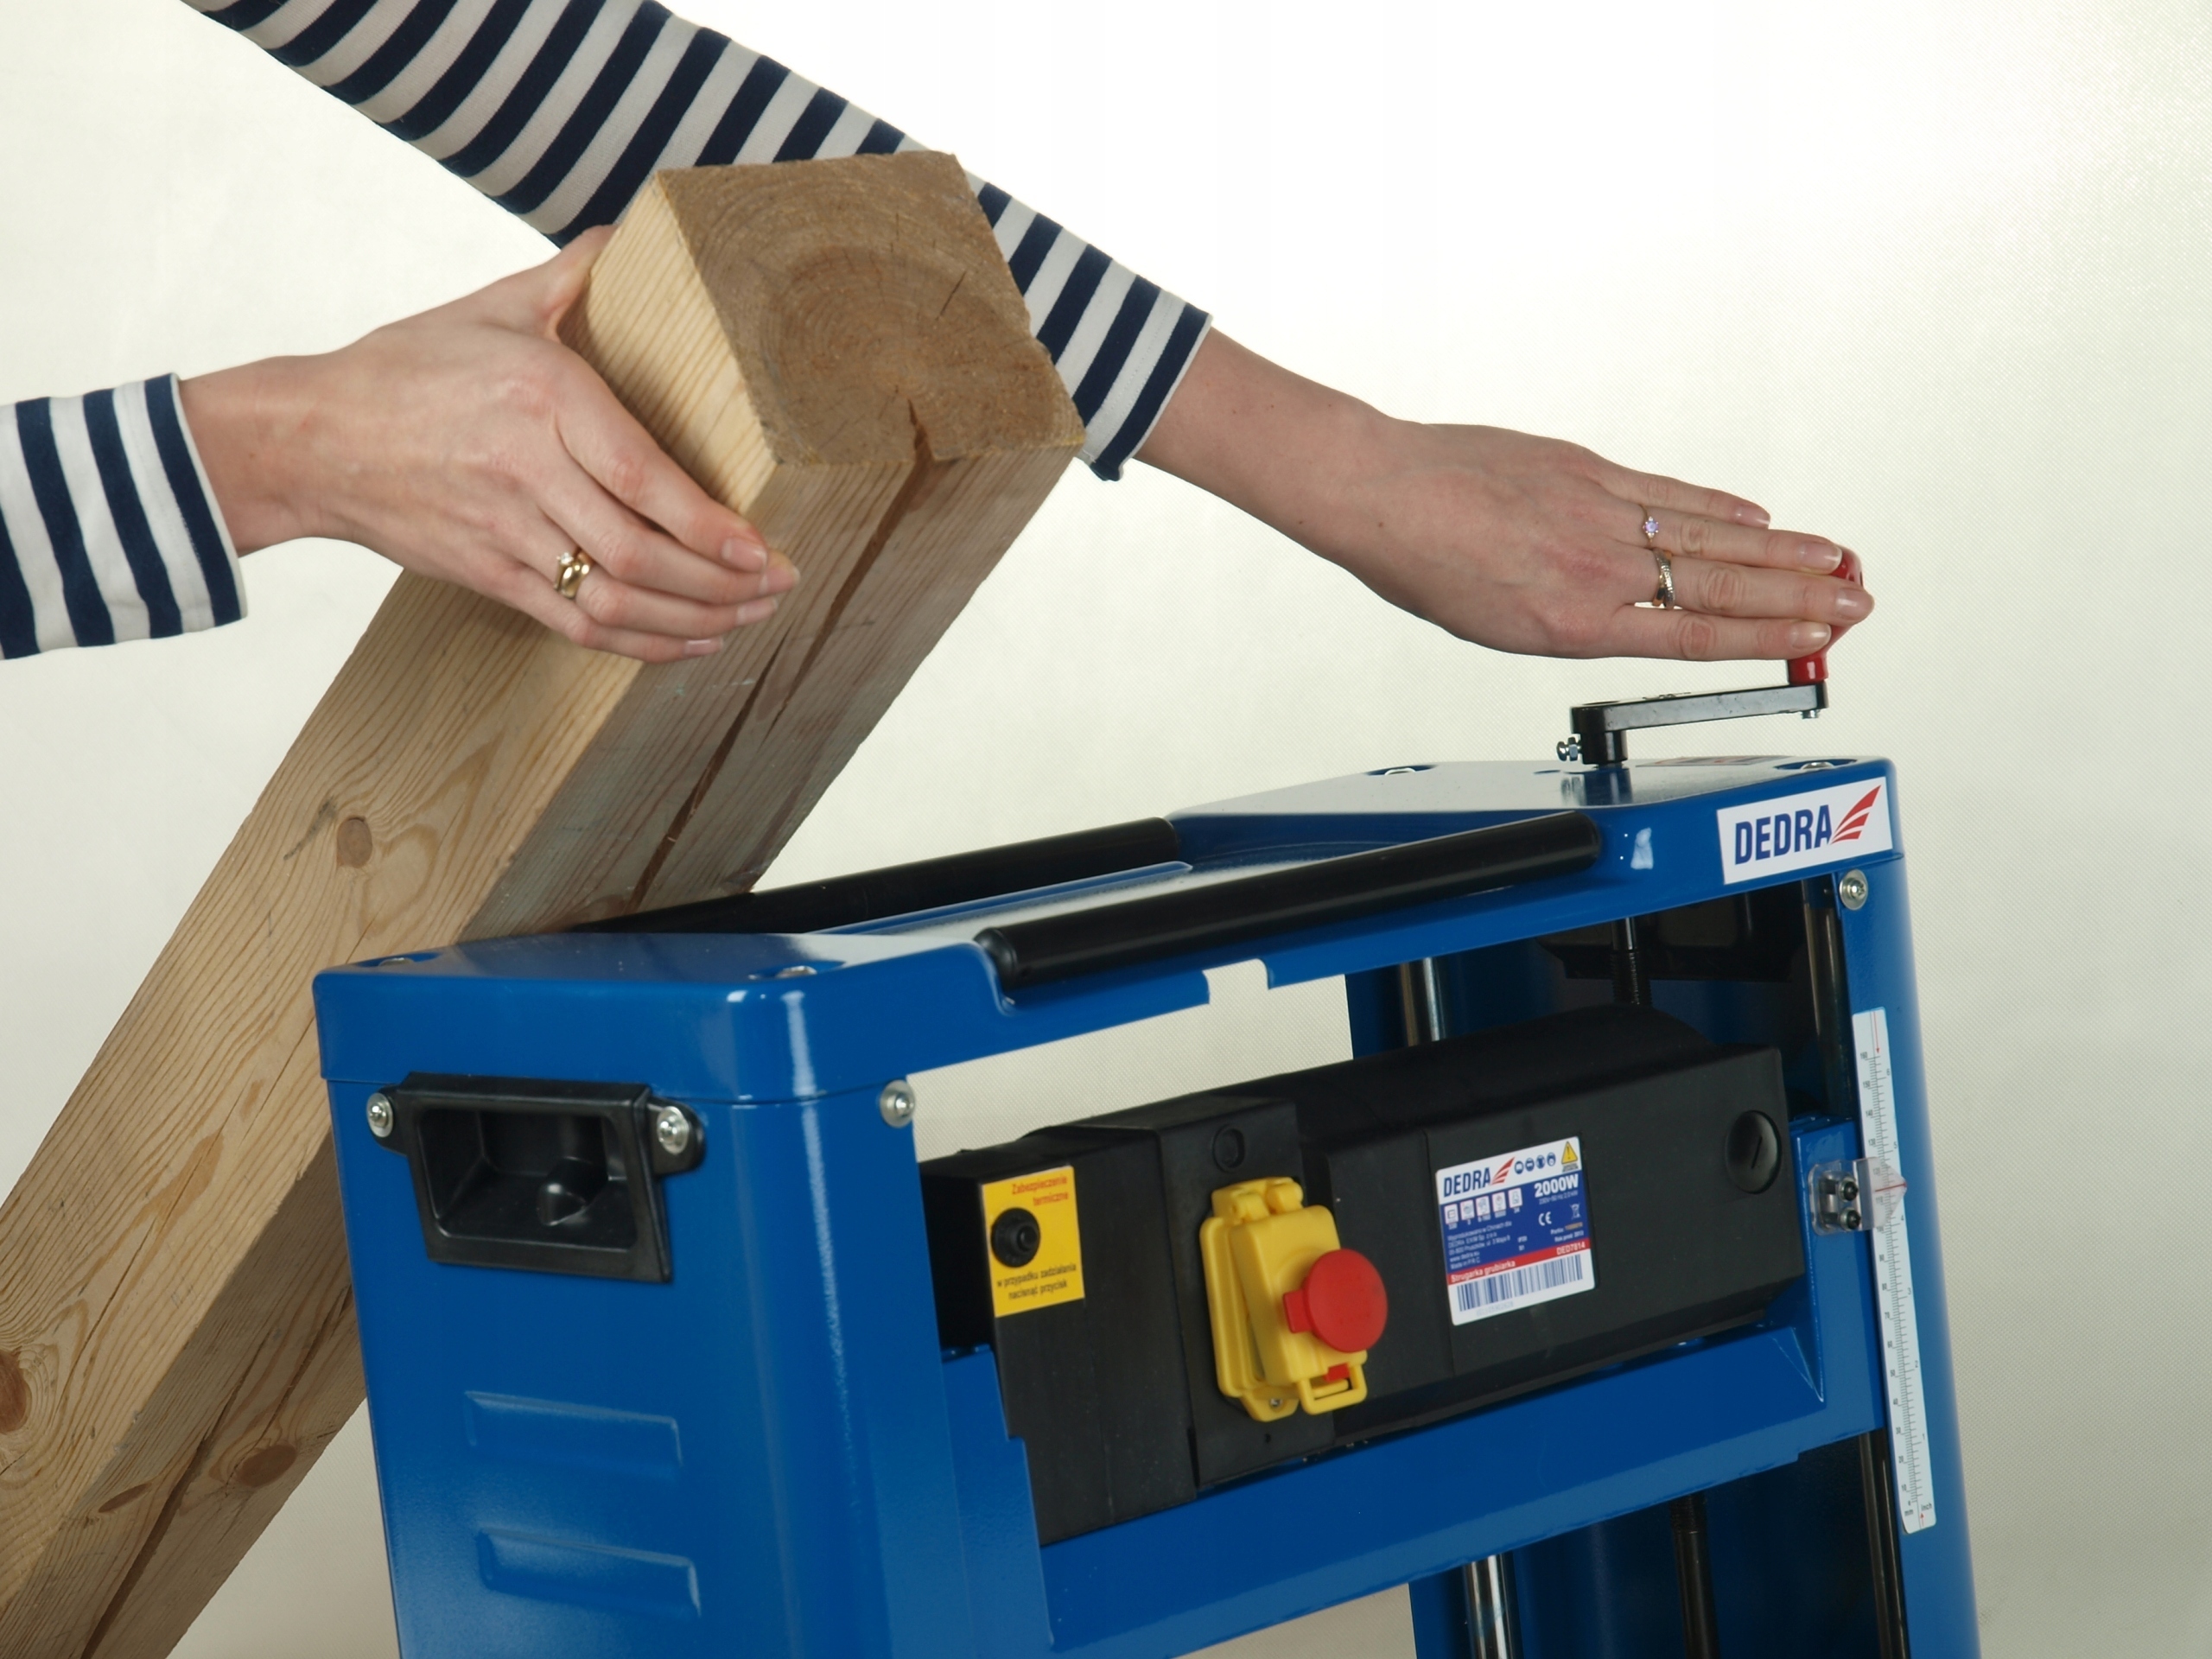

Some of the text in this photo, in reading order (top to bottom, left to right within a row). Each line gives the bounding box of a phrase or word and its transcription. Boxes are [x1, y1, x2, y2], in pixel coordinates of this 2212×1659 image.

[1735, 804, 1833, 865] DEDRA
[1444, 1167, 1491, 1198] DEDRA
[1534, 1173, 1579, 1198] 2000W
